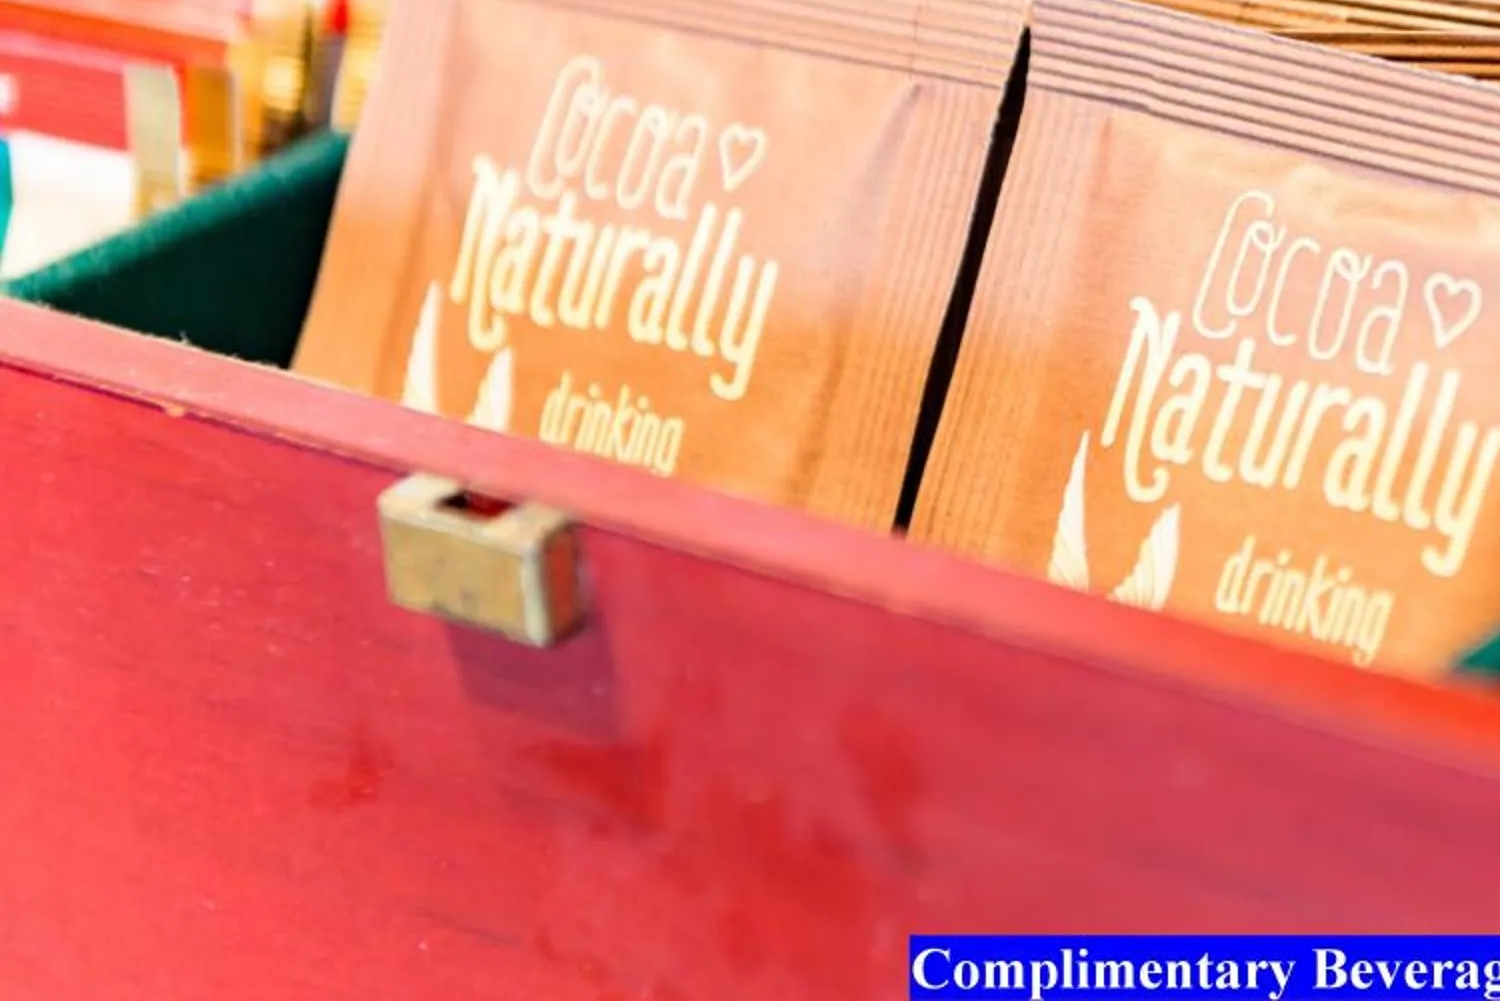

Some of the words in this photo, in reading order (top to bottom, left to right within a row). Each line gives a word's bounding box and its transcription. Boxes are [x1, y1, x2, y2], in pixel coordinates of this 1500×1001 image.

[526, 54, 707, 220] Cocoa
[450, 154, 779, 402] Naturally
[1193, 189, 1409, 376] Cocoa
[539, 369, 685, 476] drinking
[1214, 535, 1394, 667] drinking
